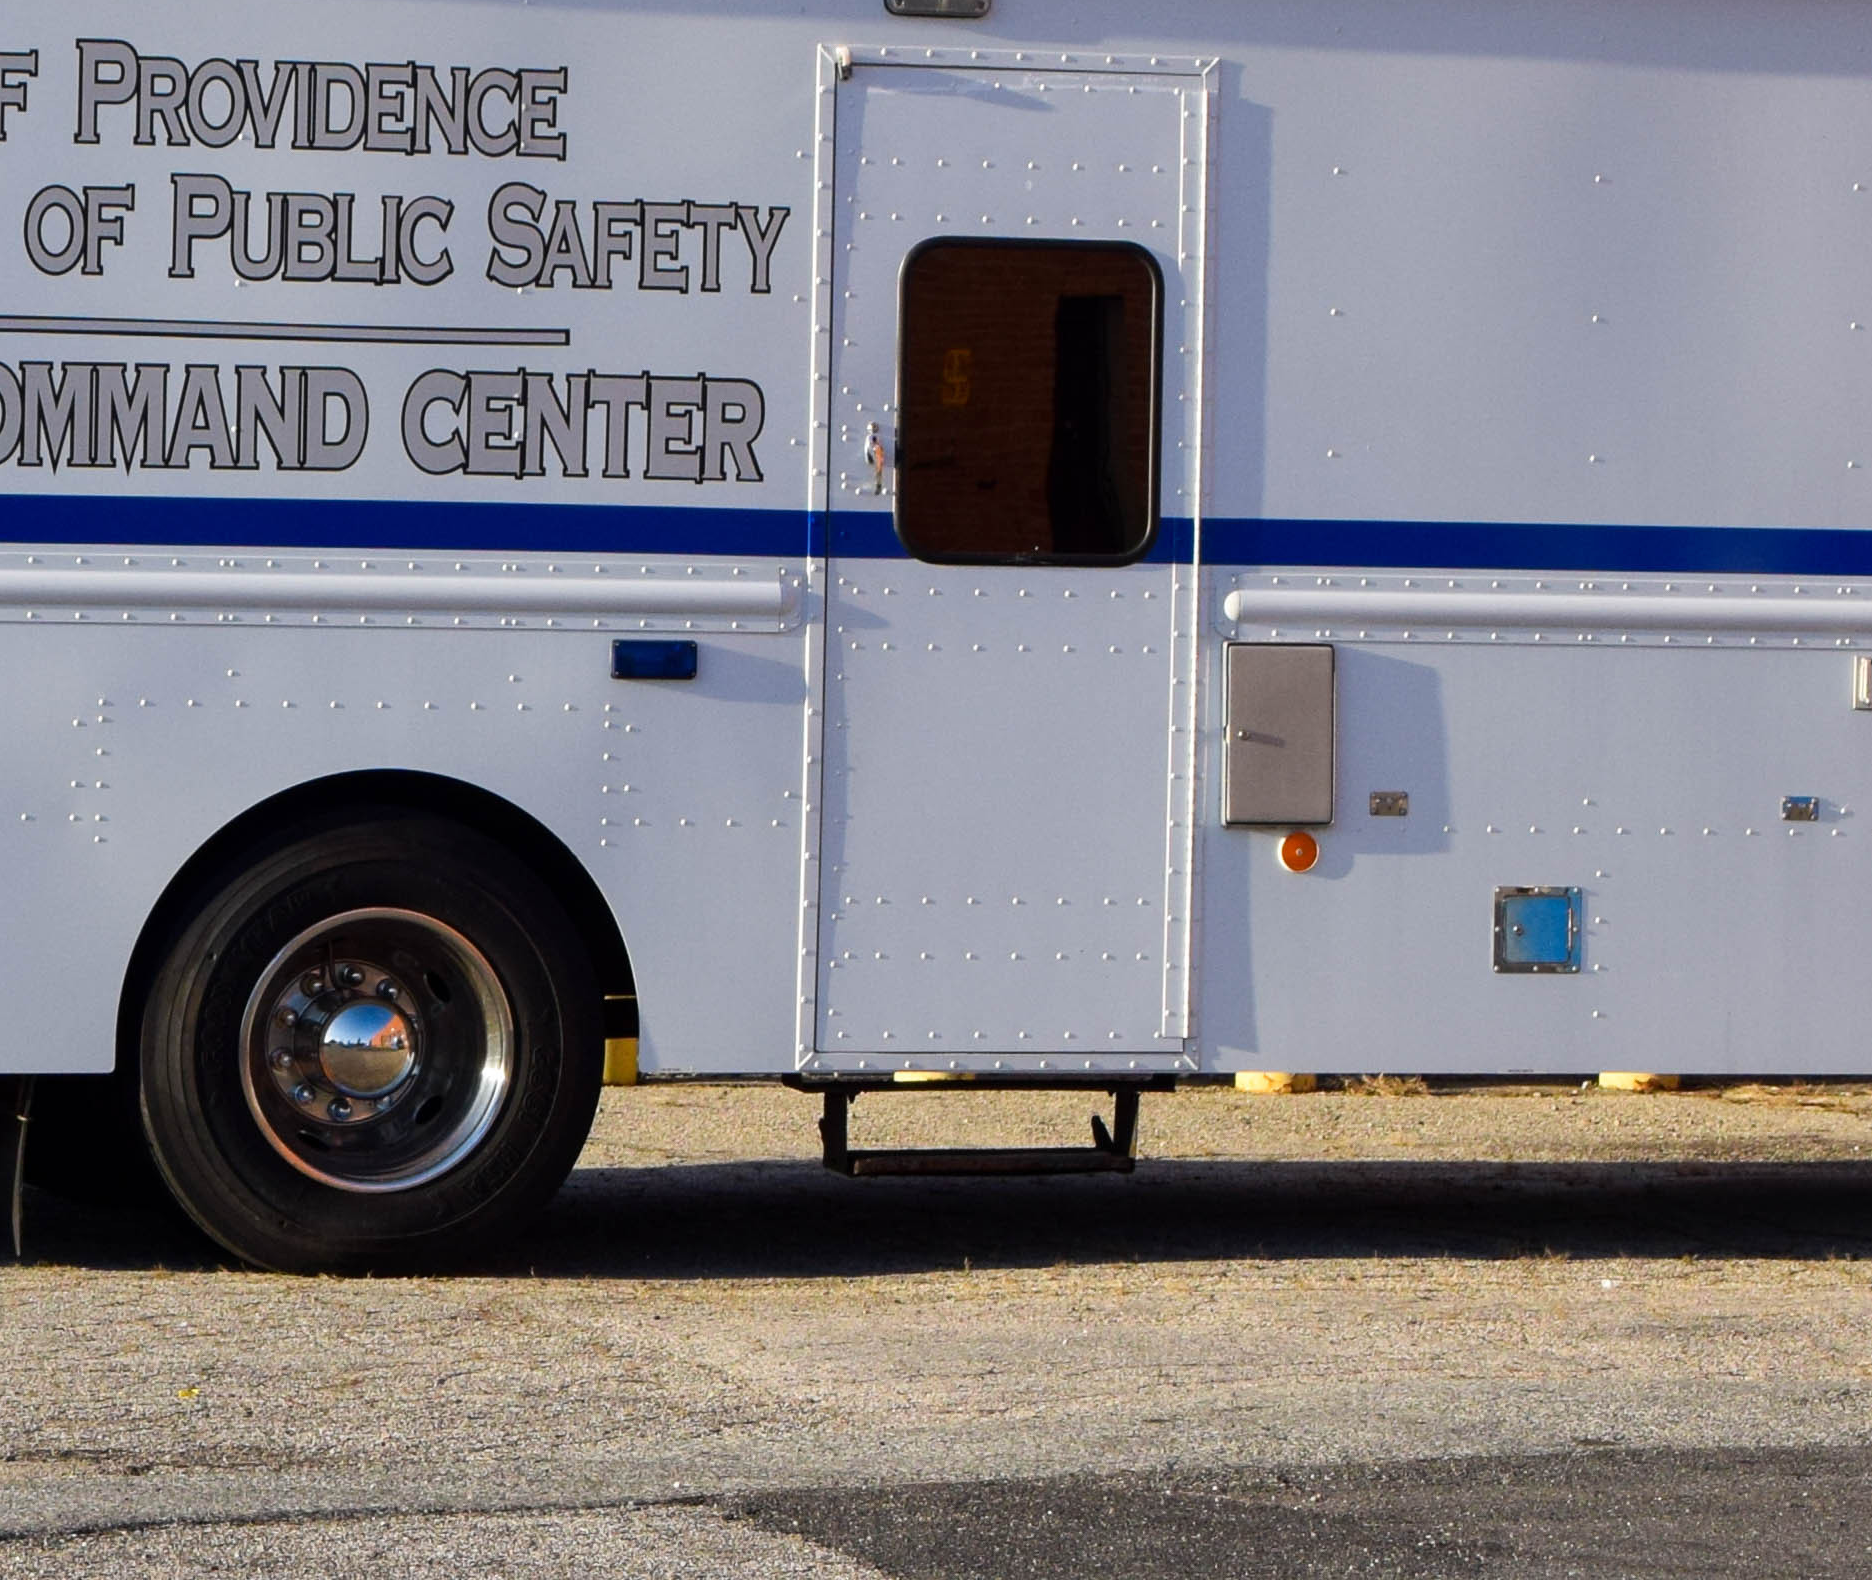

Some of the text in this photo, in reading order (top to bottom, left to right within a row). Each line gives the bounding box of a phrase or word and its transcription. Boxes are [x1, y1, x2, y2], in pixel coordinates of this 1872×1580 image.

[74, 38, 568, 160] PROVIDENCE
[24, 183, 135, 275] OF
[168, 172, 455, 285] PUBLIC
[486, 181, 791, 294] SAFETY
[401, 367, 765, 484] CENTER
